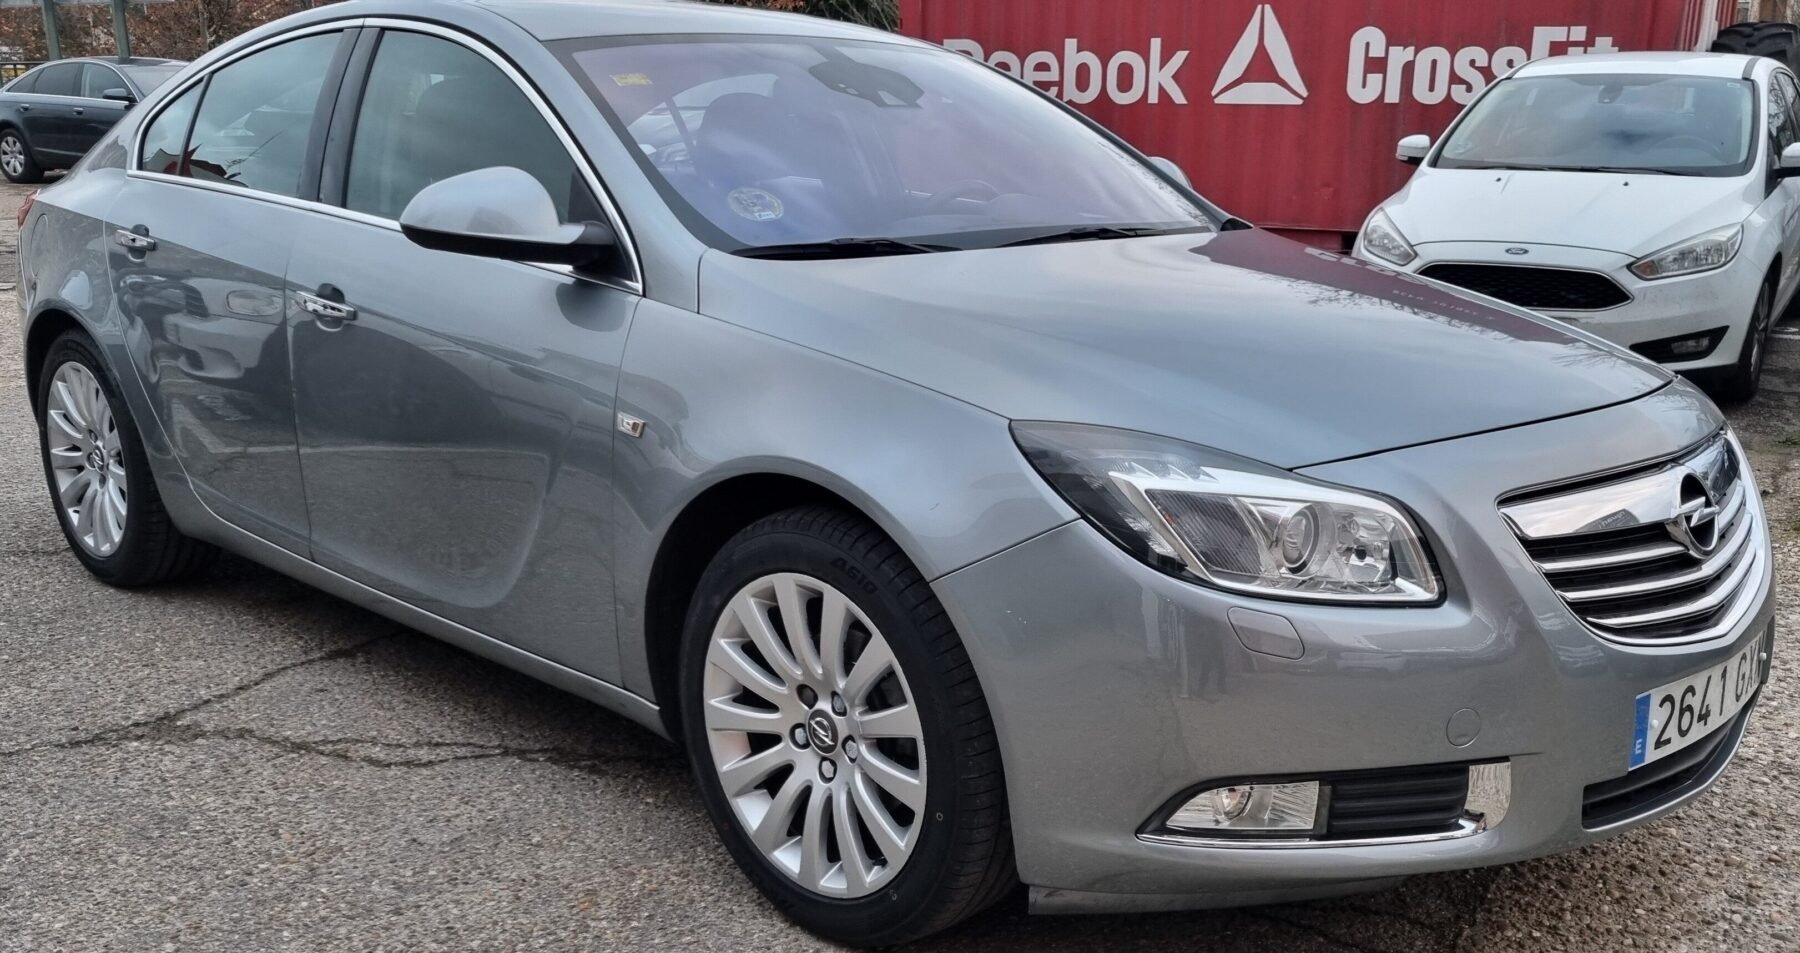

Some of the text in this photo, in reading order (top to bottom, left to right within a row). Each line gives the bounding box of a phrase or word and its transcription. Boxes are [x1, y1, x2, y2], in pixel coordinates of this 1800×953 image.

[1346, 26, 1619, 105] Cross
[1635, 738, 1643, 754] E
[1653, 665, 1728, 751] 2641
